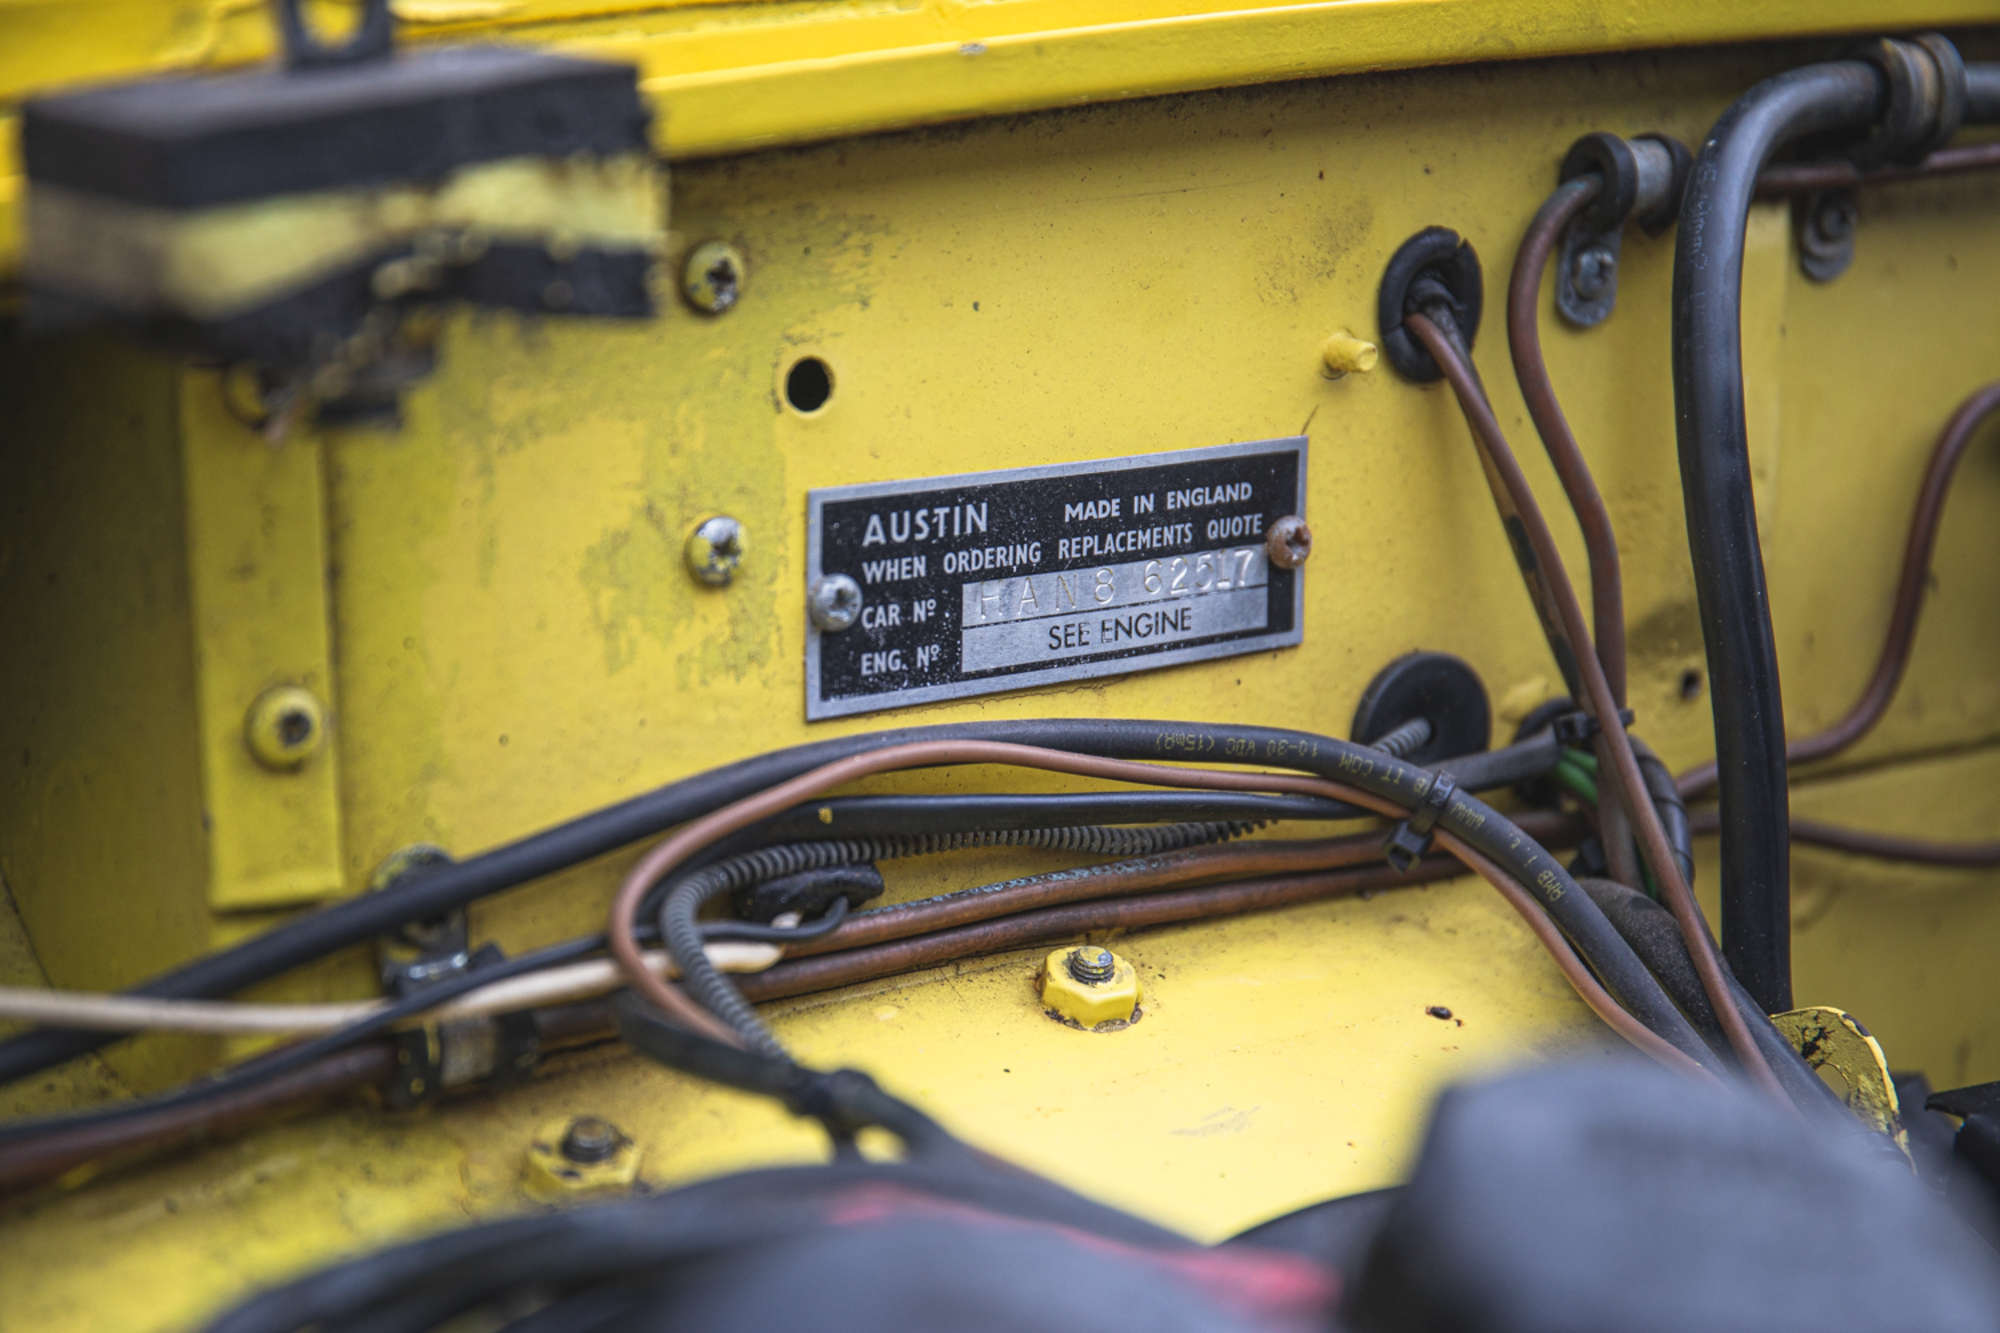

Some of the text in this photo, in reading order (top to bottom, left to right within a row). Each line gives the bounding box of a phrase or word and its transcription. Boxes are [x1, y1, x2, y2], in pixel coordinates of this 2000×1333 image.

[862, 502, 988, 547] AUSTIN
[1064, 482, 1253, 523] MADE IN ENGLAND
[862, 513, 1264, 585] WHEN ORDERING REPLACEMENTS QUOTE
[861, 603, 901, 629] CAR
[860, 649, 908, 677] ENG.
[1048, 621, 1091, 651] SEE
[1101, 606, 1193, 645] ENGINE
